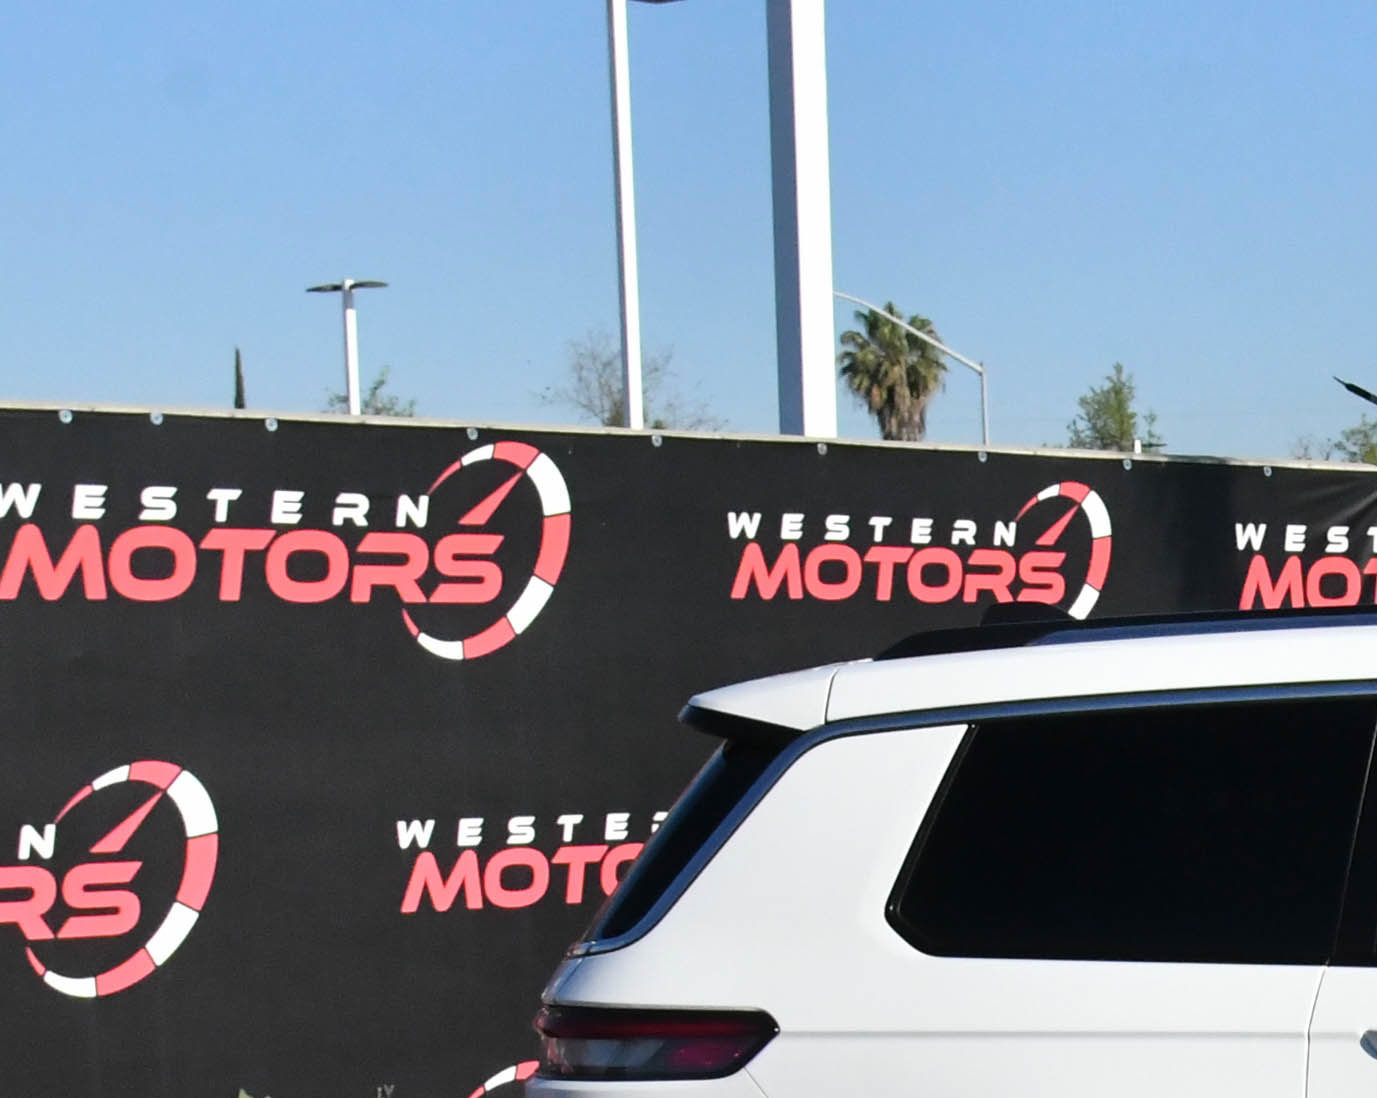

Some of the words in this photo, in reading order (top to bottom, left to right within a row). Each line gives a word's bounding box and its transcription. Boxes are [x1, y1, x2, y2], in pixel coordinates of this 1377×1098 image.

[0, 482, 430, 528] WESTERN
[727, 511, 1017, 547] WESTERN
[0, 522, 505, 604] MOTORS
[730, 541, 1067, 605] MOTORS
